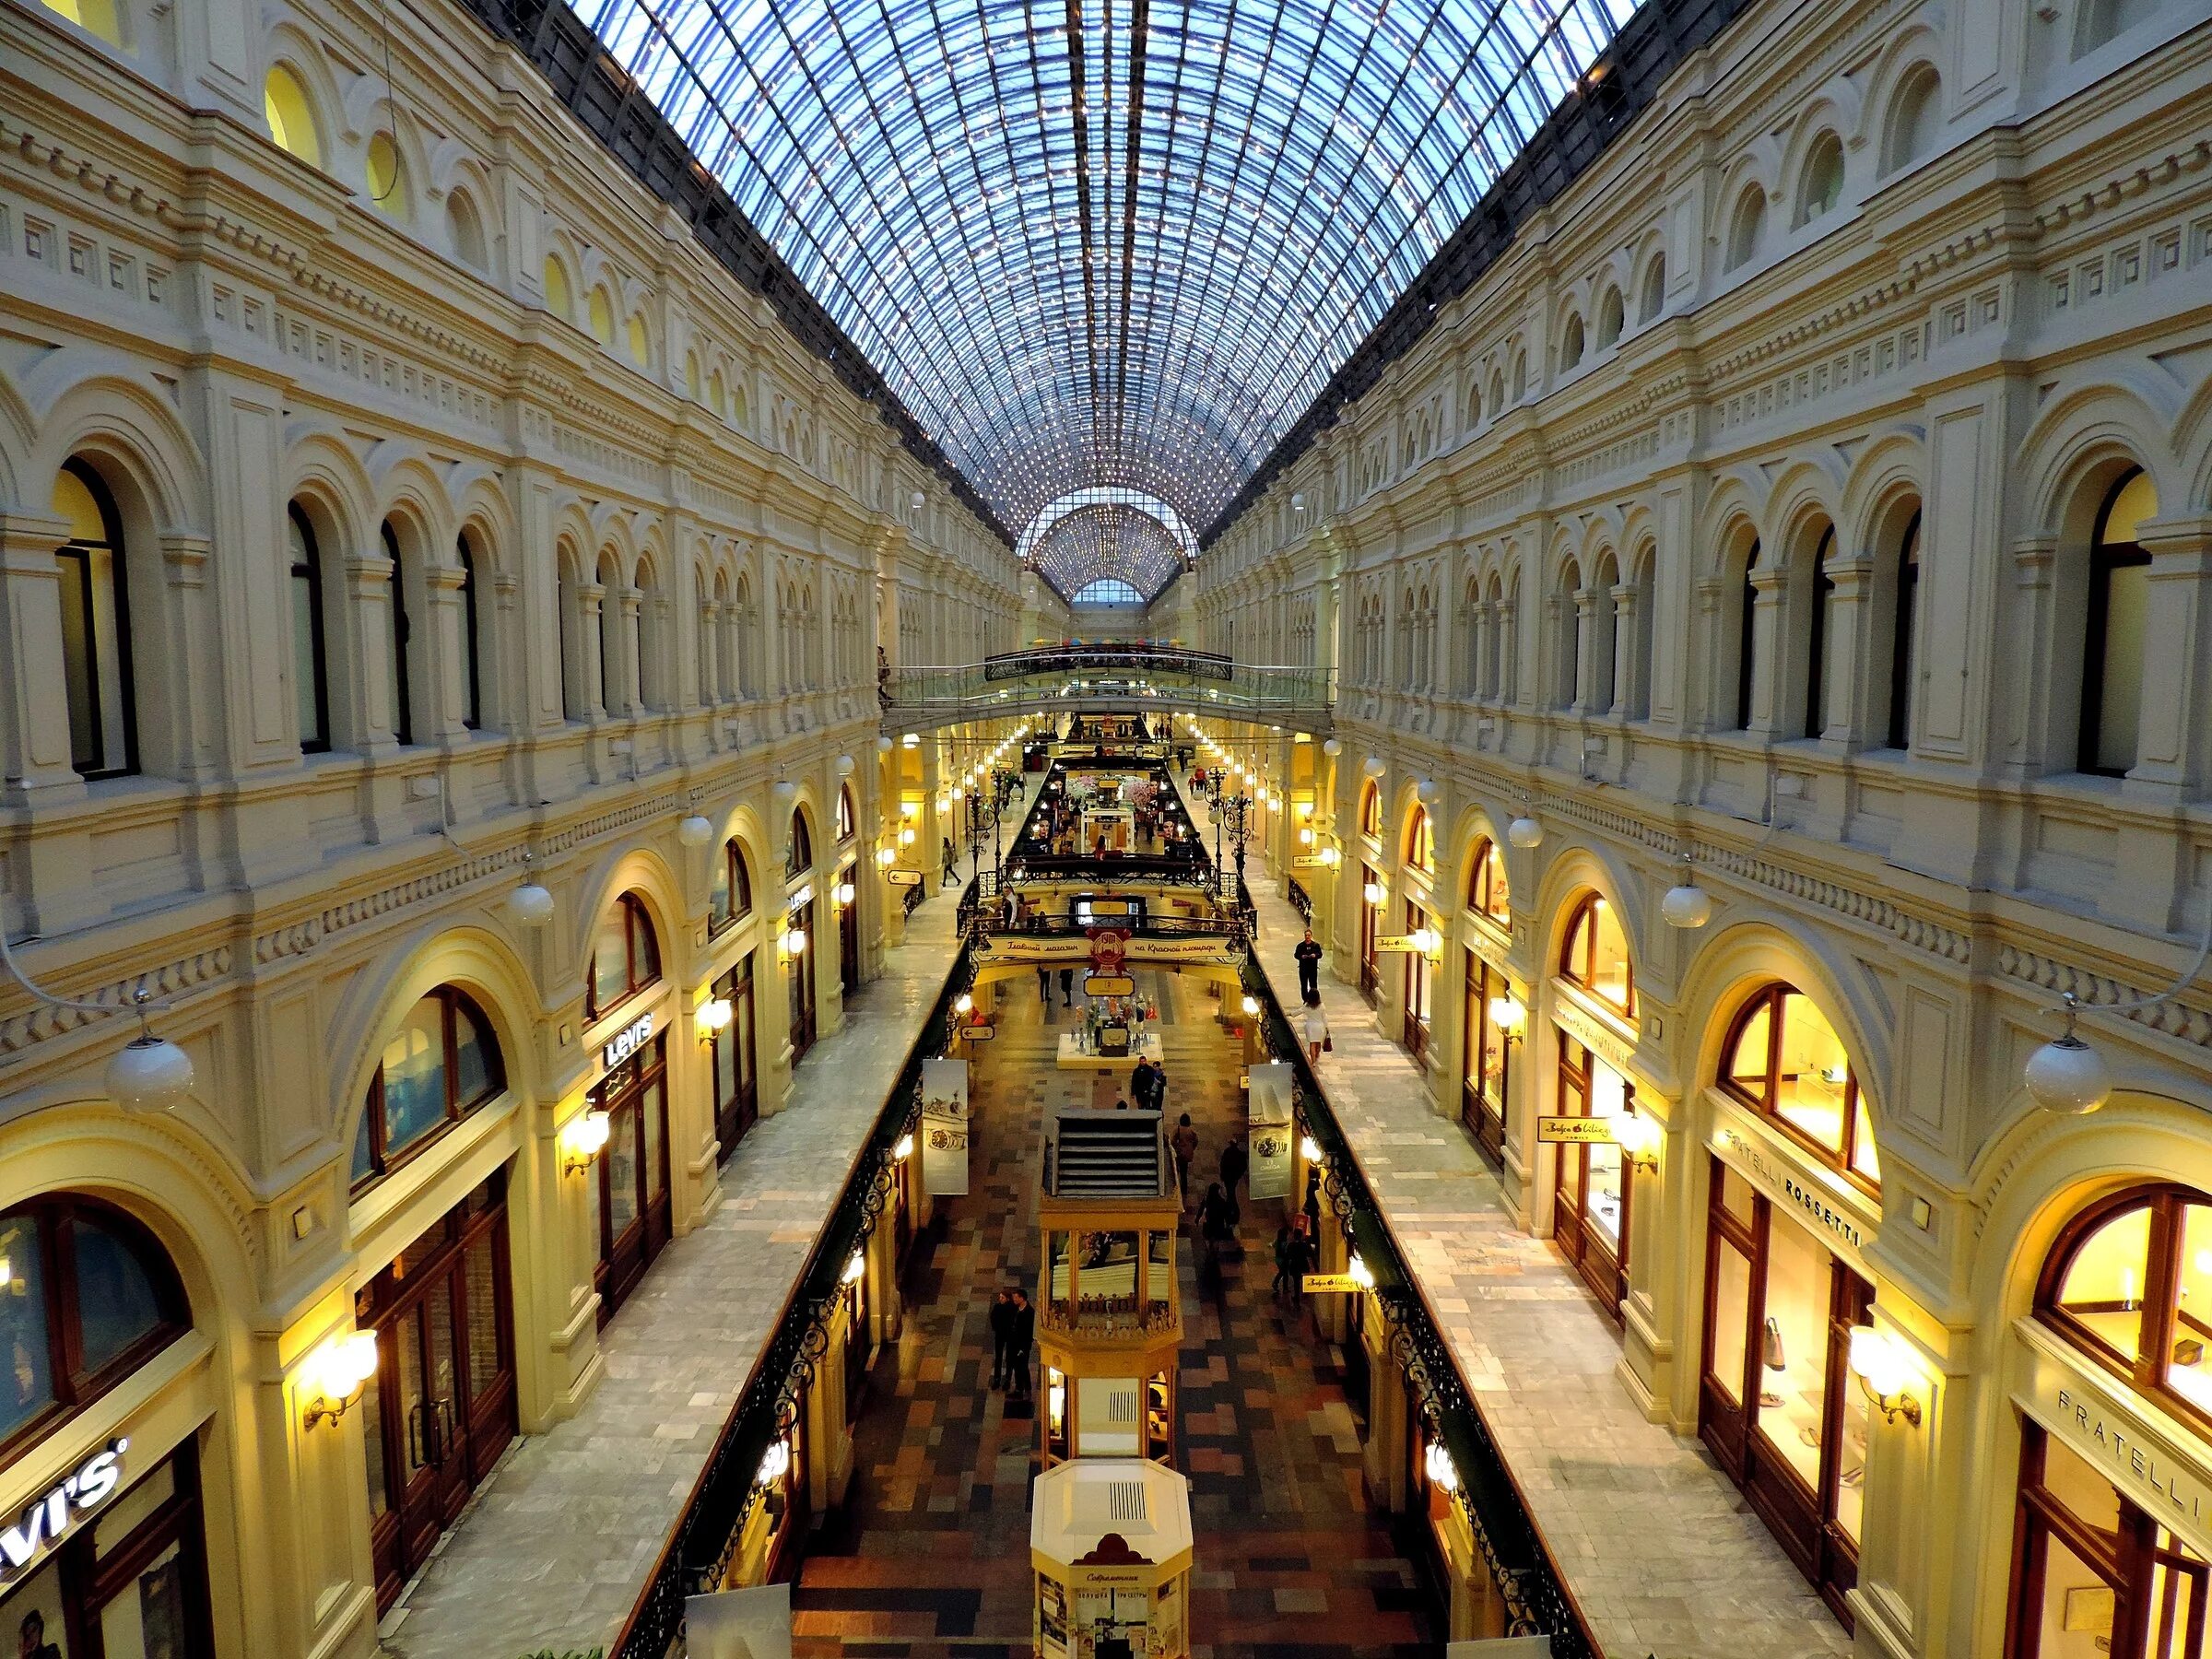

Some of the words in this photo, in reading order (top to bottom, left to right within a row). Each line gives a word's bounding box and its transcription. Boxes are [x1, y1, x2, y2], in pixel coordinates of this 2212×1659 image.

[1006, 941, 1041, 952] Главный
[1044, 944, 1079, 952] магазин
[1147, 943, 1182, 954] Красной
[1182, 944, 1217, 952] площади
[1785, 1178, 1860, 1247] ROSSETTI
[2058, 1389, 2200, 1517] FRATELLI
[1086, 1572, 1139, 1583] Современник
